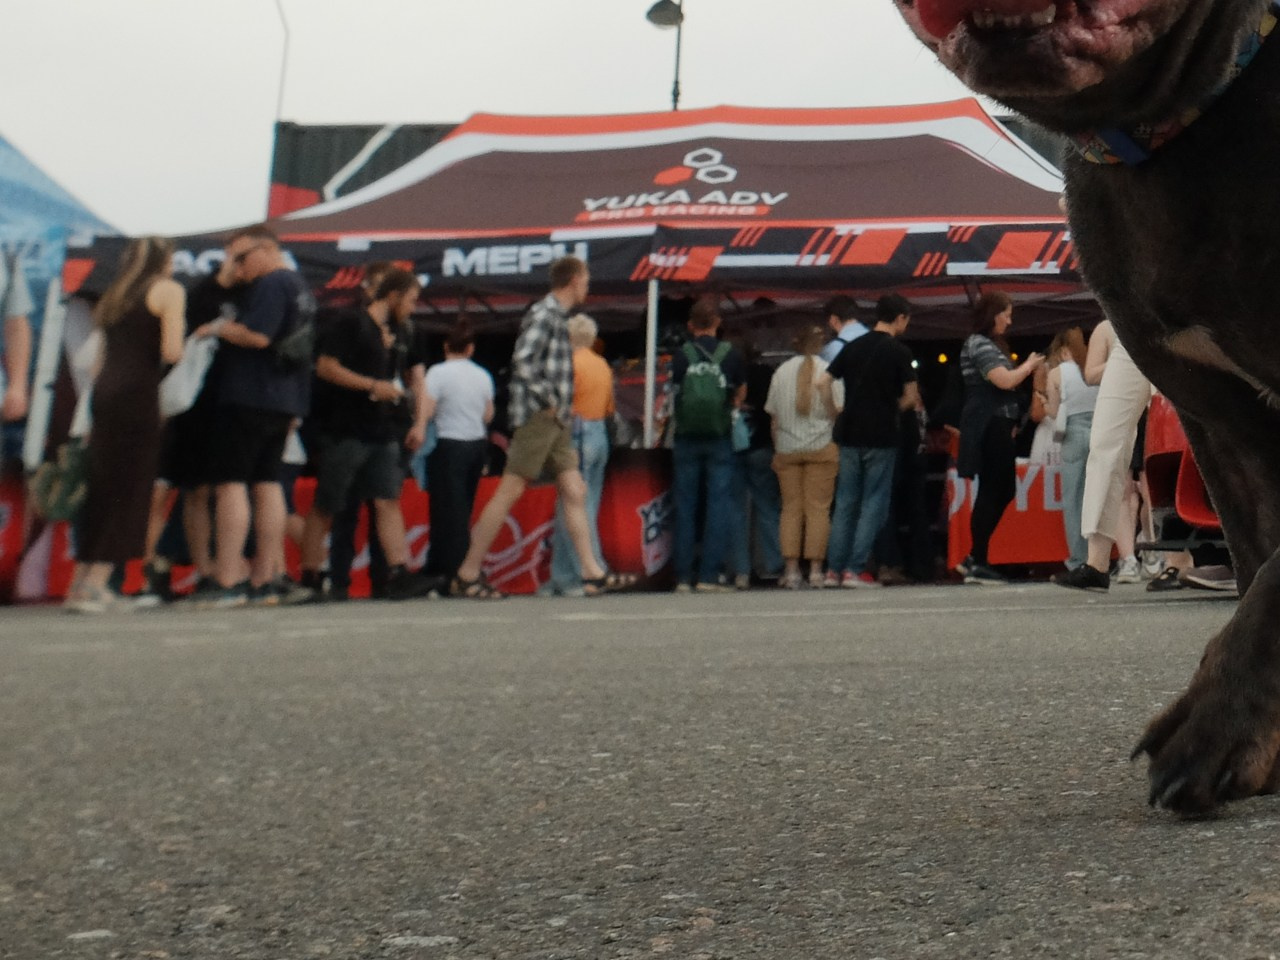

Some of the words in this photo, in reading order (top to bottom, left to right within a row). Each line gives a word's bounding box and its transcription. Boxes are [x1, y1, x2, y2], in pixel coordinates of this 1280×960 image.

[583, 189, 691, 211] YUKA
[698, 190, 789, 206] ADV
[651, 205, 757, 217] RACING
